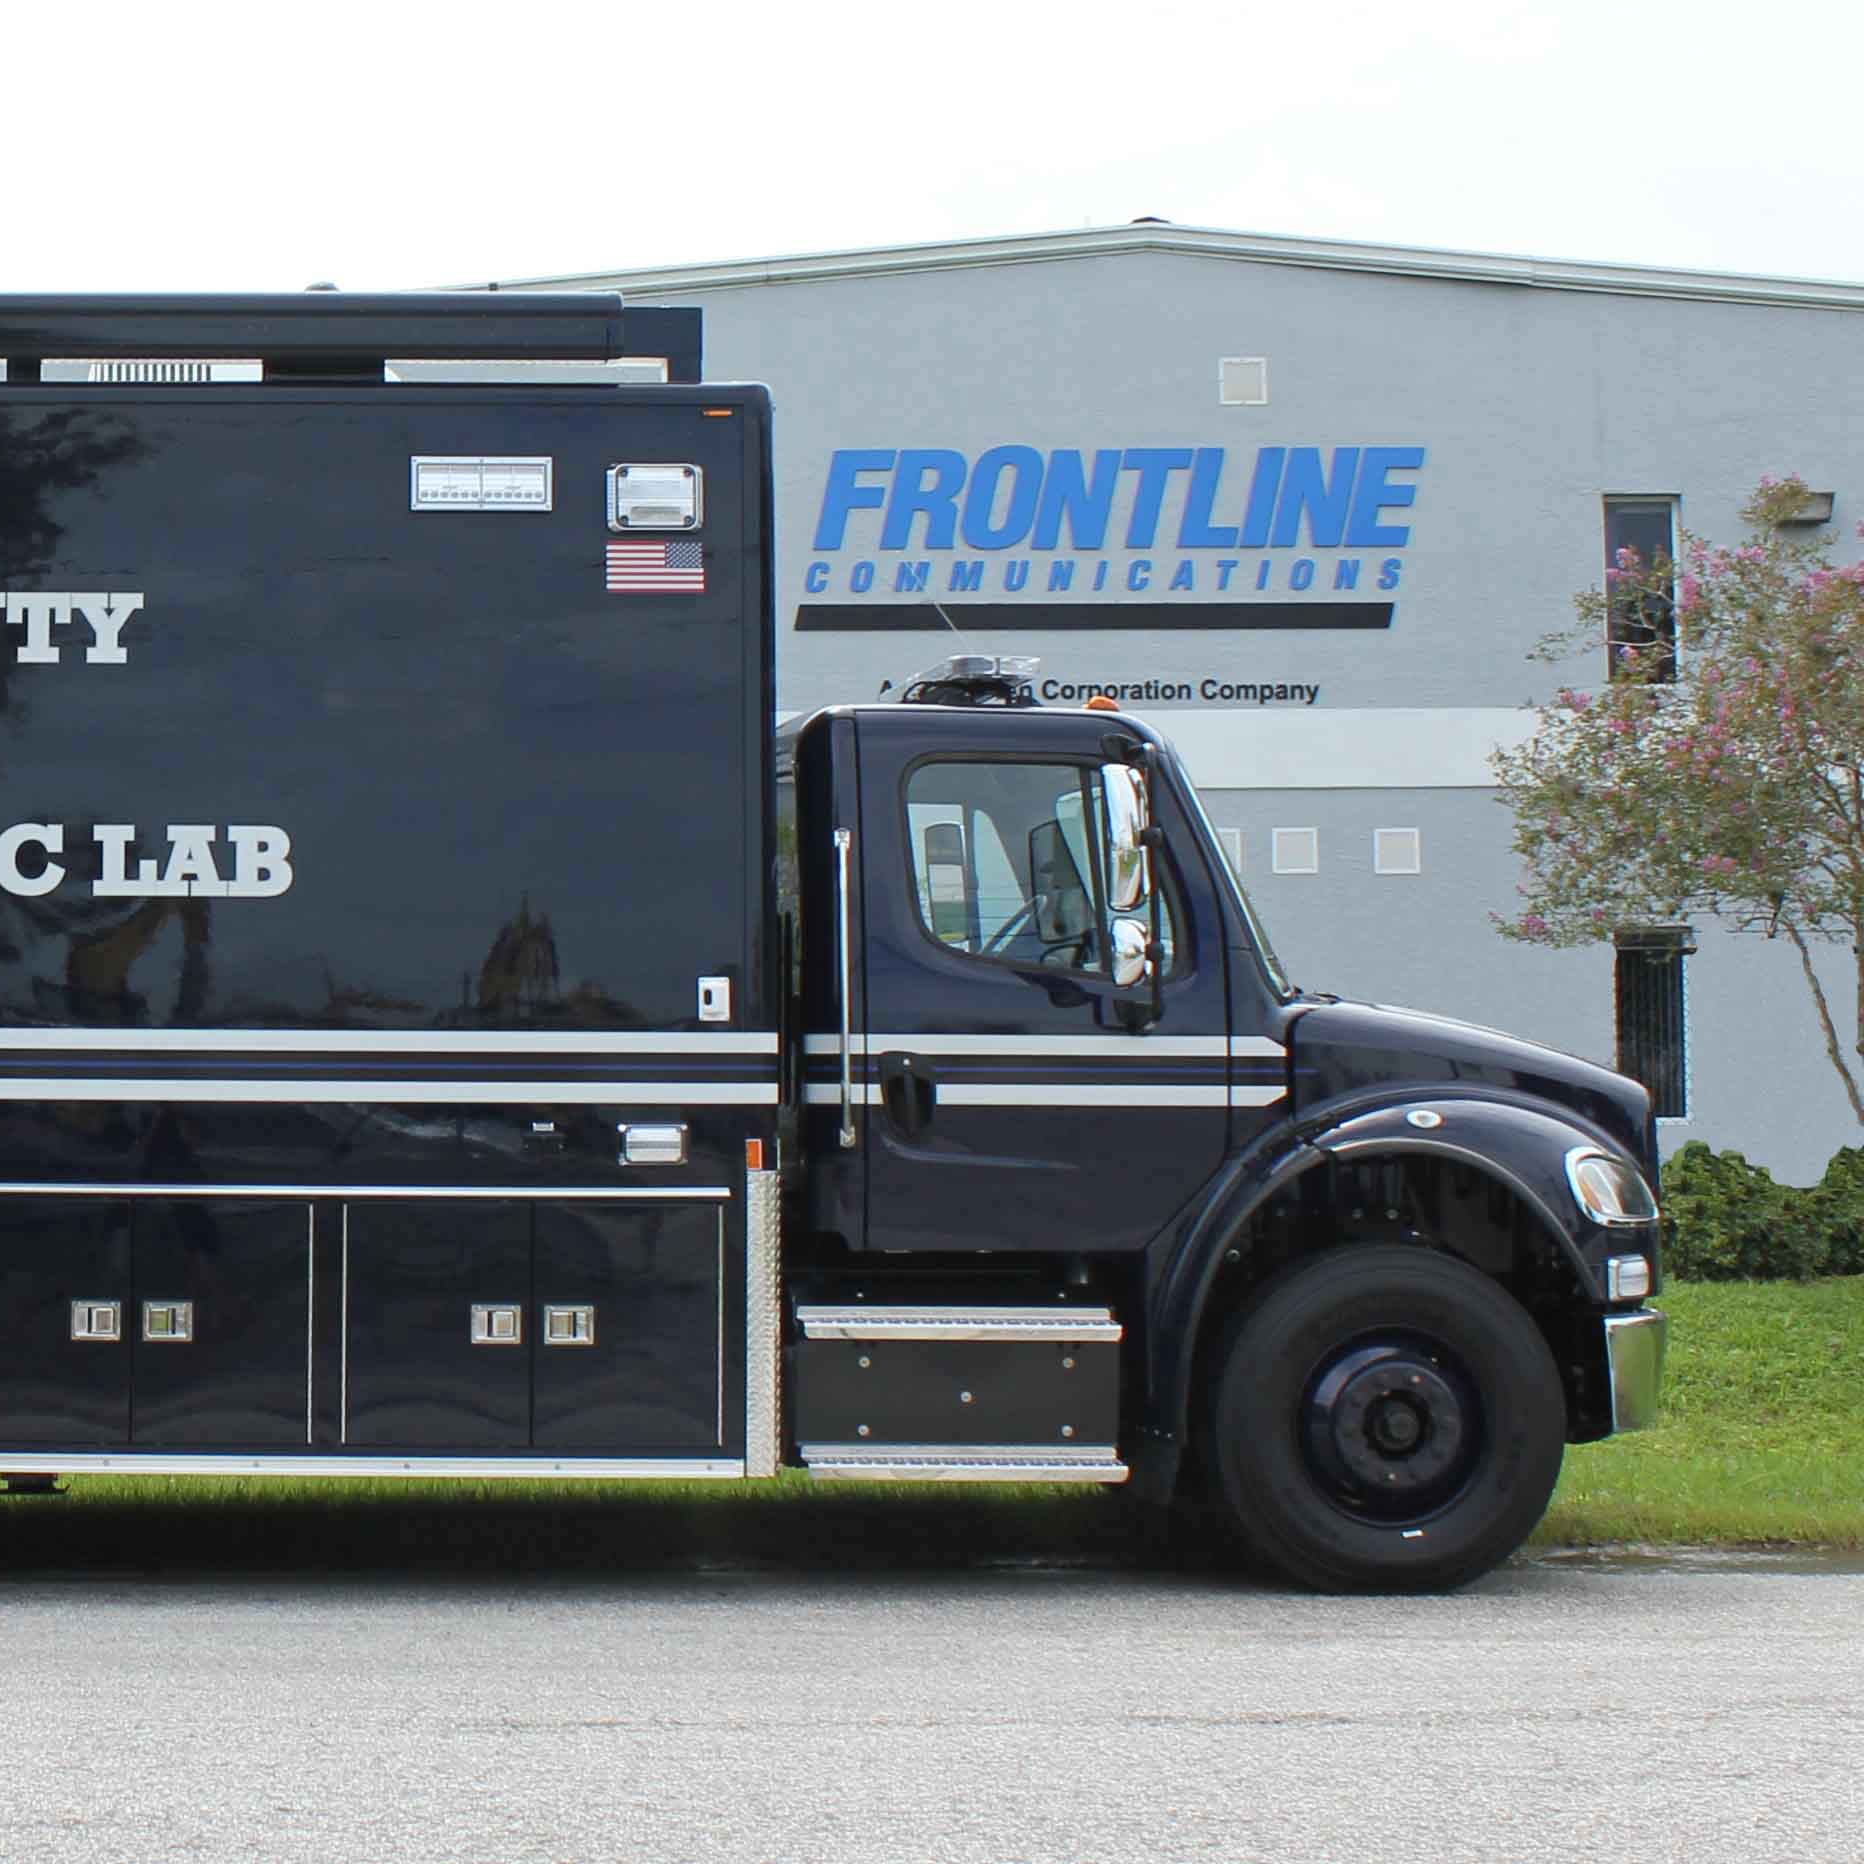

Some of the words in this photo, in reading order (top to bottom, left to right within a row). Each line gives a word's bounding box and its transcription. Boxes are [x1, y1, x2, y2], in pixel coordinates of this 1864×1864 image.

[813, 444, 1426, 551] FRONTLINE
[805, 558, 1402, 593] COMMUNICATIONS
[1041, 679, 1192, 702] Corporation
[1199, 679, 1320, 704] Company
[92, 824, 293, 897] LAB
